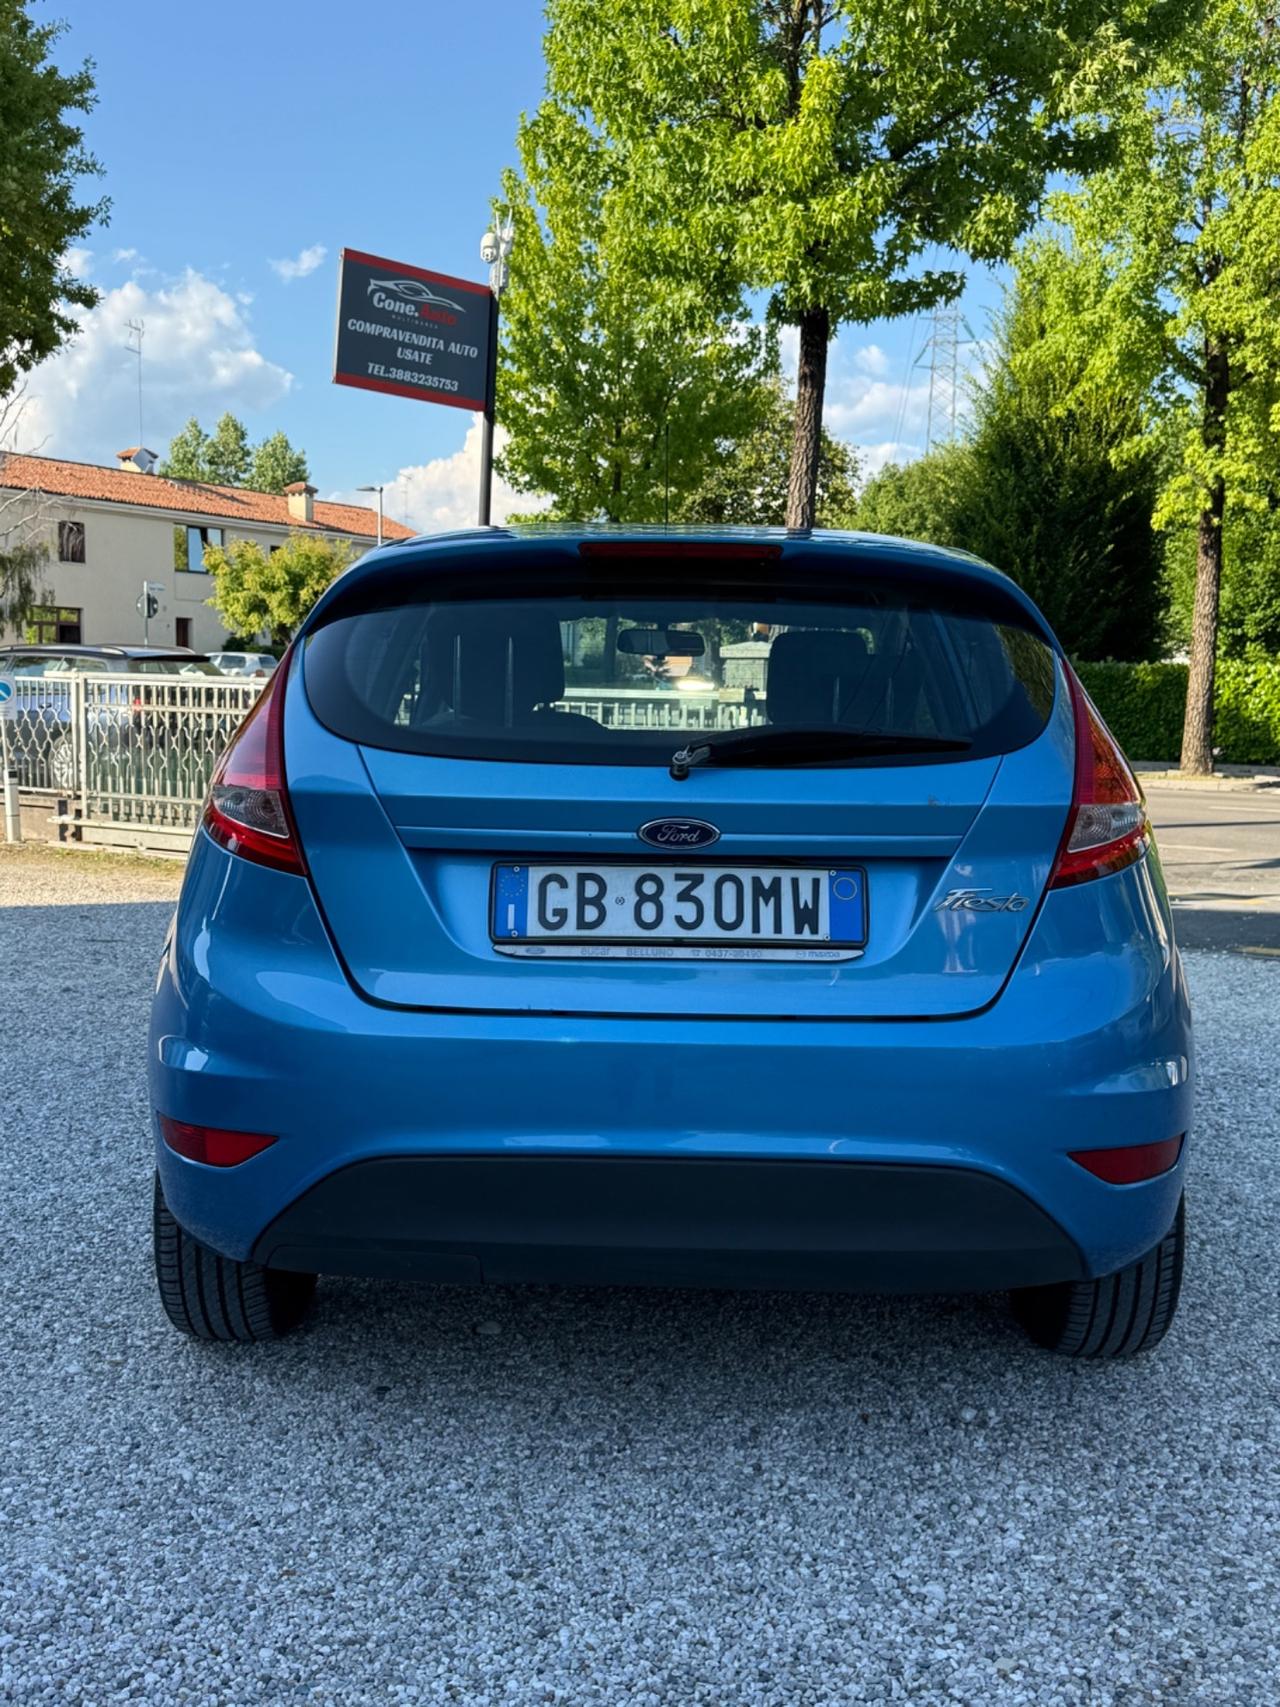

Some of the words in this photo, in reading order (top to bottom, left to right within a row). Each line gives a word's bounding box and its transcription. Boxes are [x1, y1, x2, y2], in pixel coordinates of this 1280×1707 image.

[347, 318, 445, 351] COMPRAVENDITA
[448, 342, 478, 358] AUTO
[396, 347, 433, 365] USATE
[657, 824, 700, 842] Ford
[537, 872, 608, 931] GB
[633, 872, 821, 935] 830MW
[935, 887, 1030, 912] Fiesta
